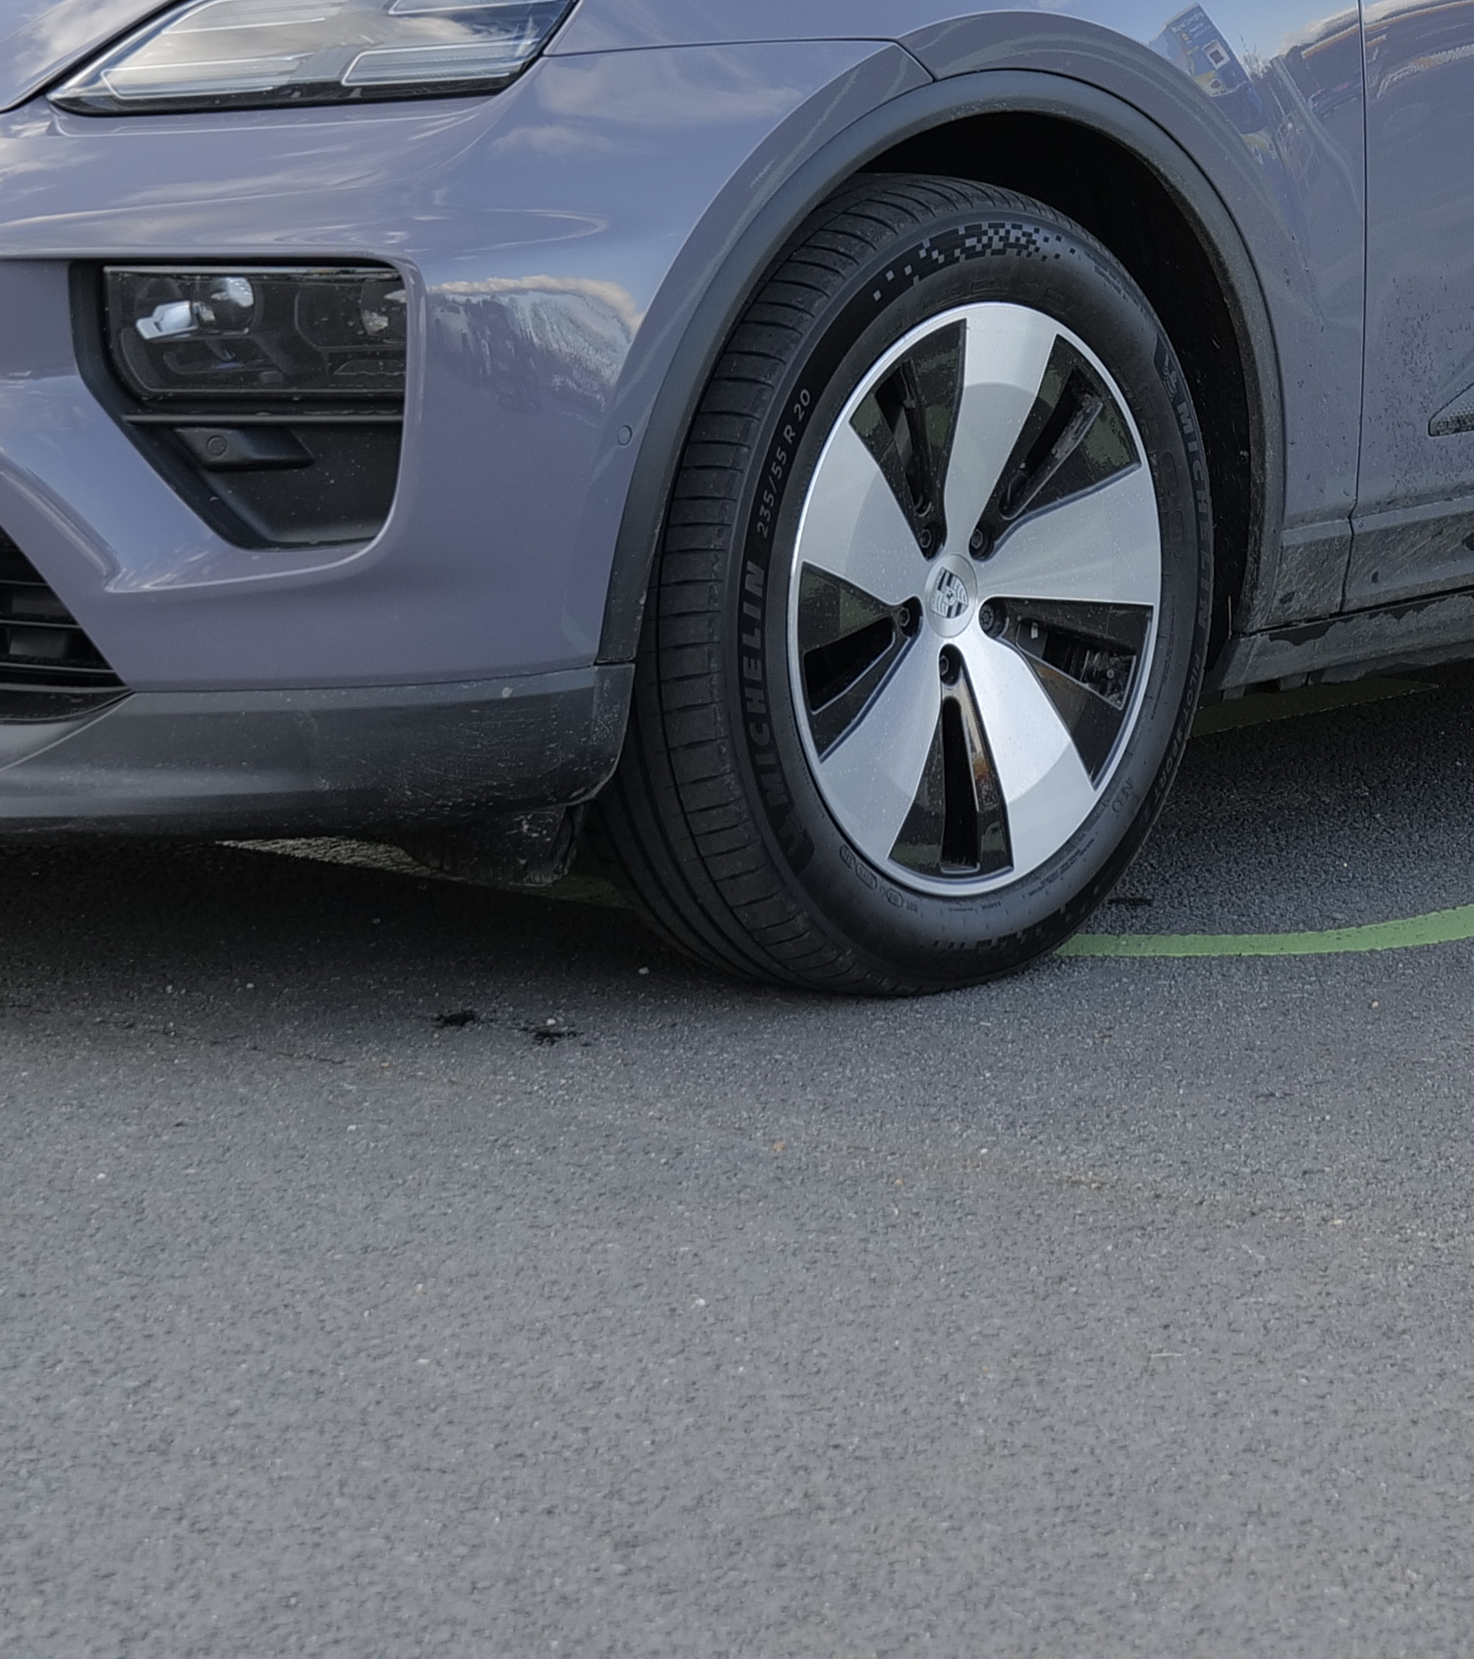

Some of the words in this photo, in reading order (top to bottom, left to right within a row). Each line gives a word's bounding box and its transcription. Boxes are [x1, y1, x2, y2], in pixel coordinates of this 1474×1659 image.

[782, 424, 798, 444] R
[793, 387, 812, 420] 20
[756, 448, 788, 540] 235/55
[738, 560, 791, 806] MICHELIN
